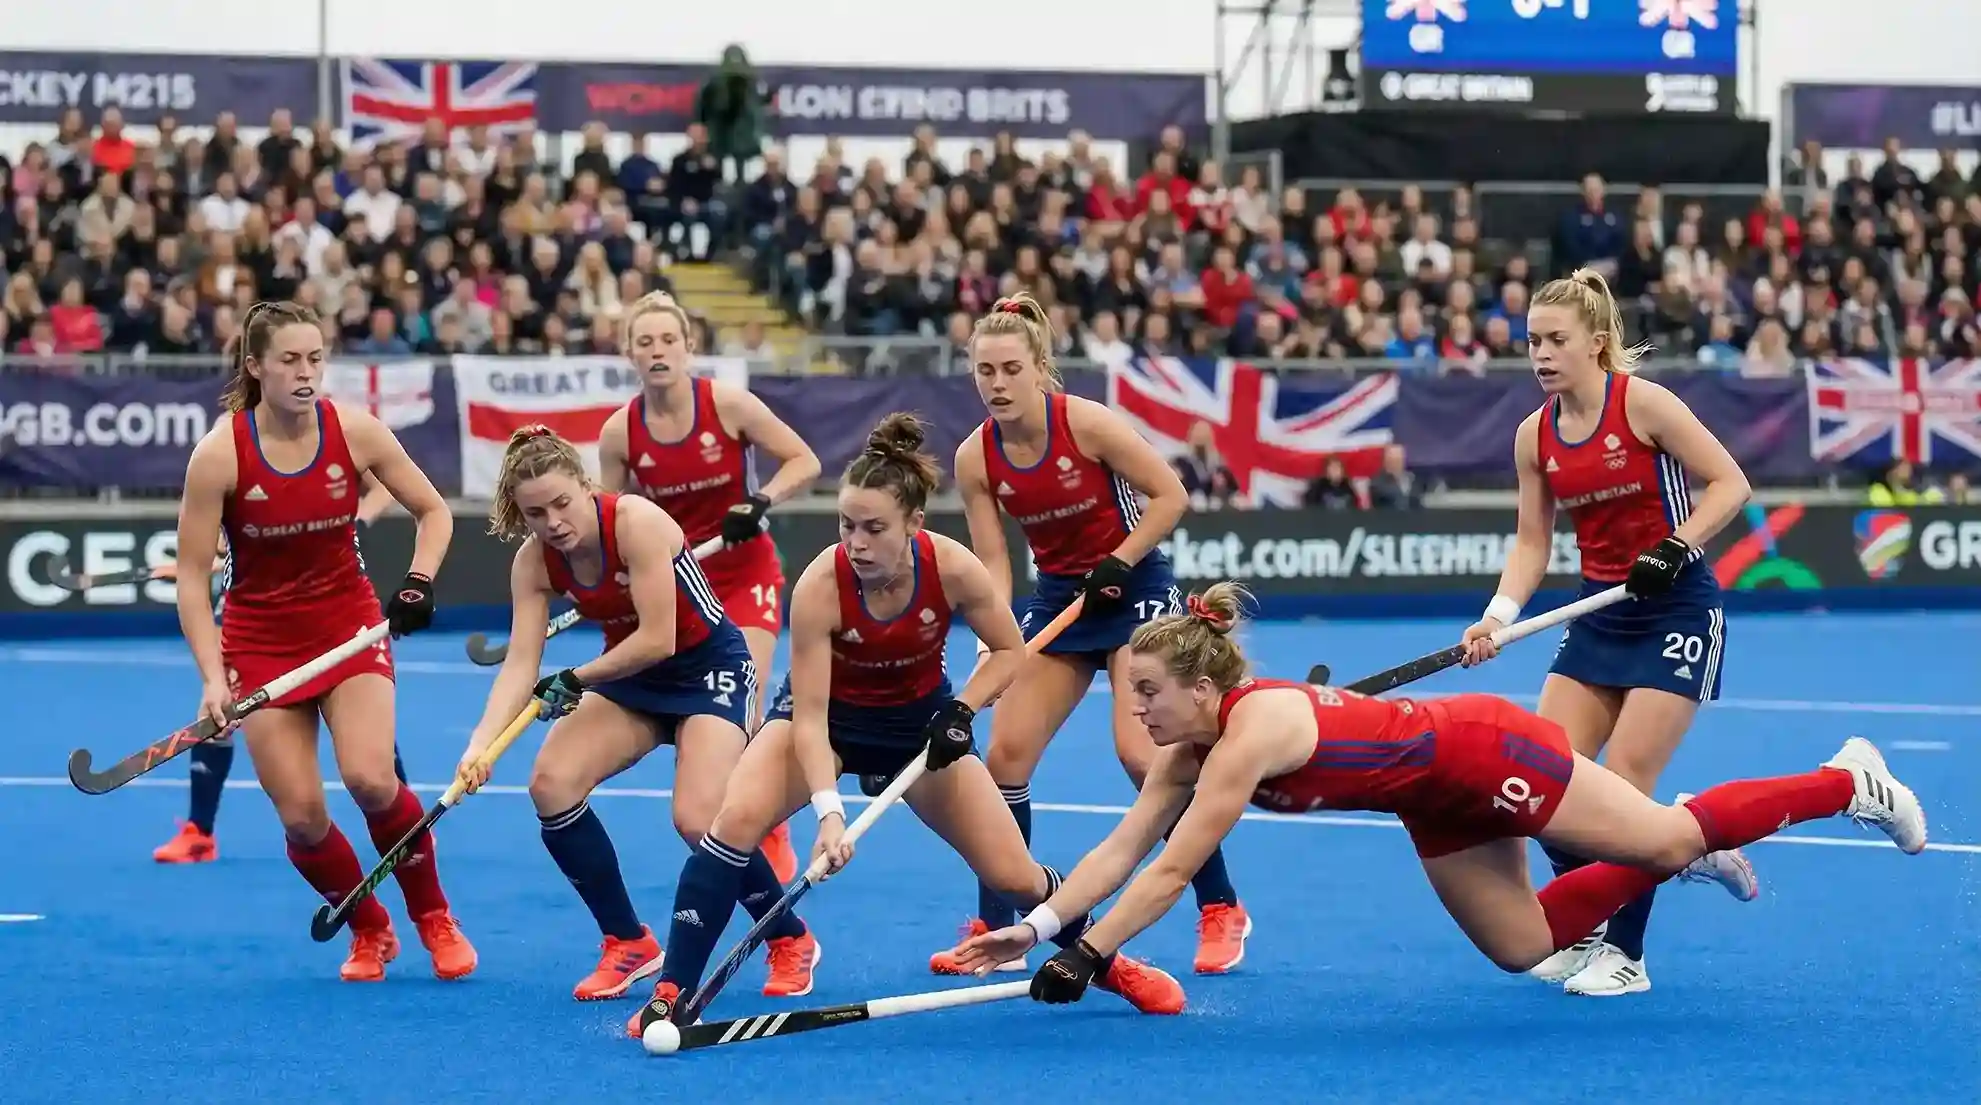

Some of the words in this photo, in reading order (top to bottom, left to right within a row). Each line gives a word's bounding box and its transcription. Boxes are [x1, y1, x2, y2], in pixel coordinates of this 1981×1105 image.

[488, 368, 590, 394] GREAT
[262, 523, 304, 538] GREAT
[750, 584, 776, 609] 14
[1134, 600, 1165, 620] 17
[1662, 632, 1703, 663] 20
[704, 671, 737, 694] 15
[1493, 776, 1531, 814] 10
